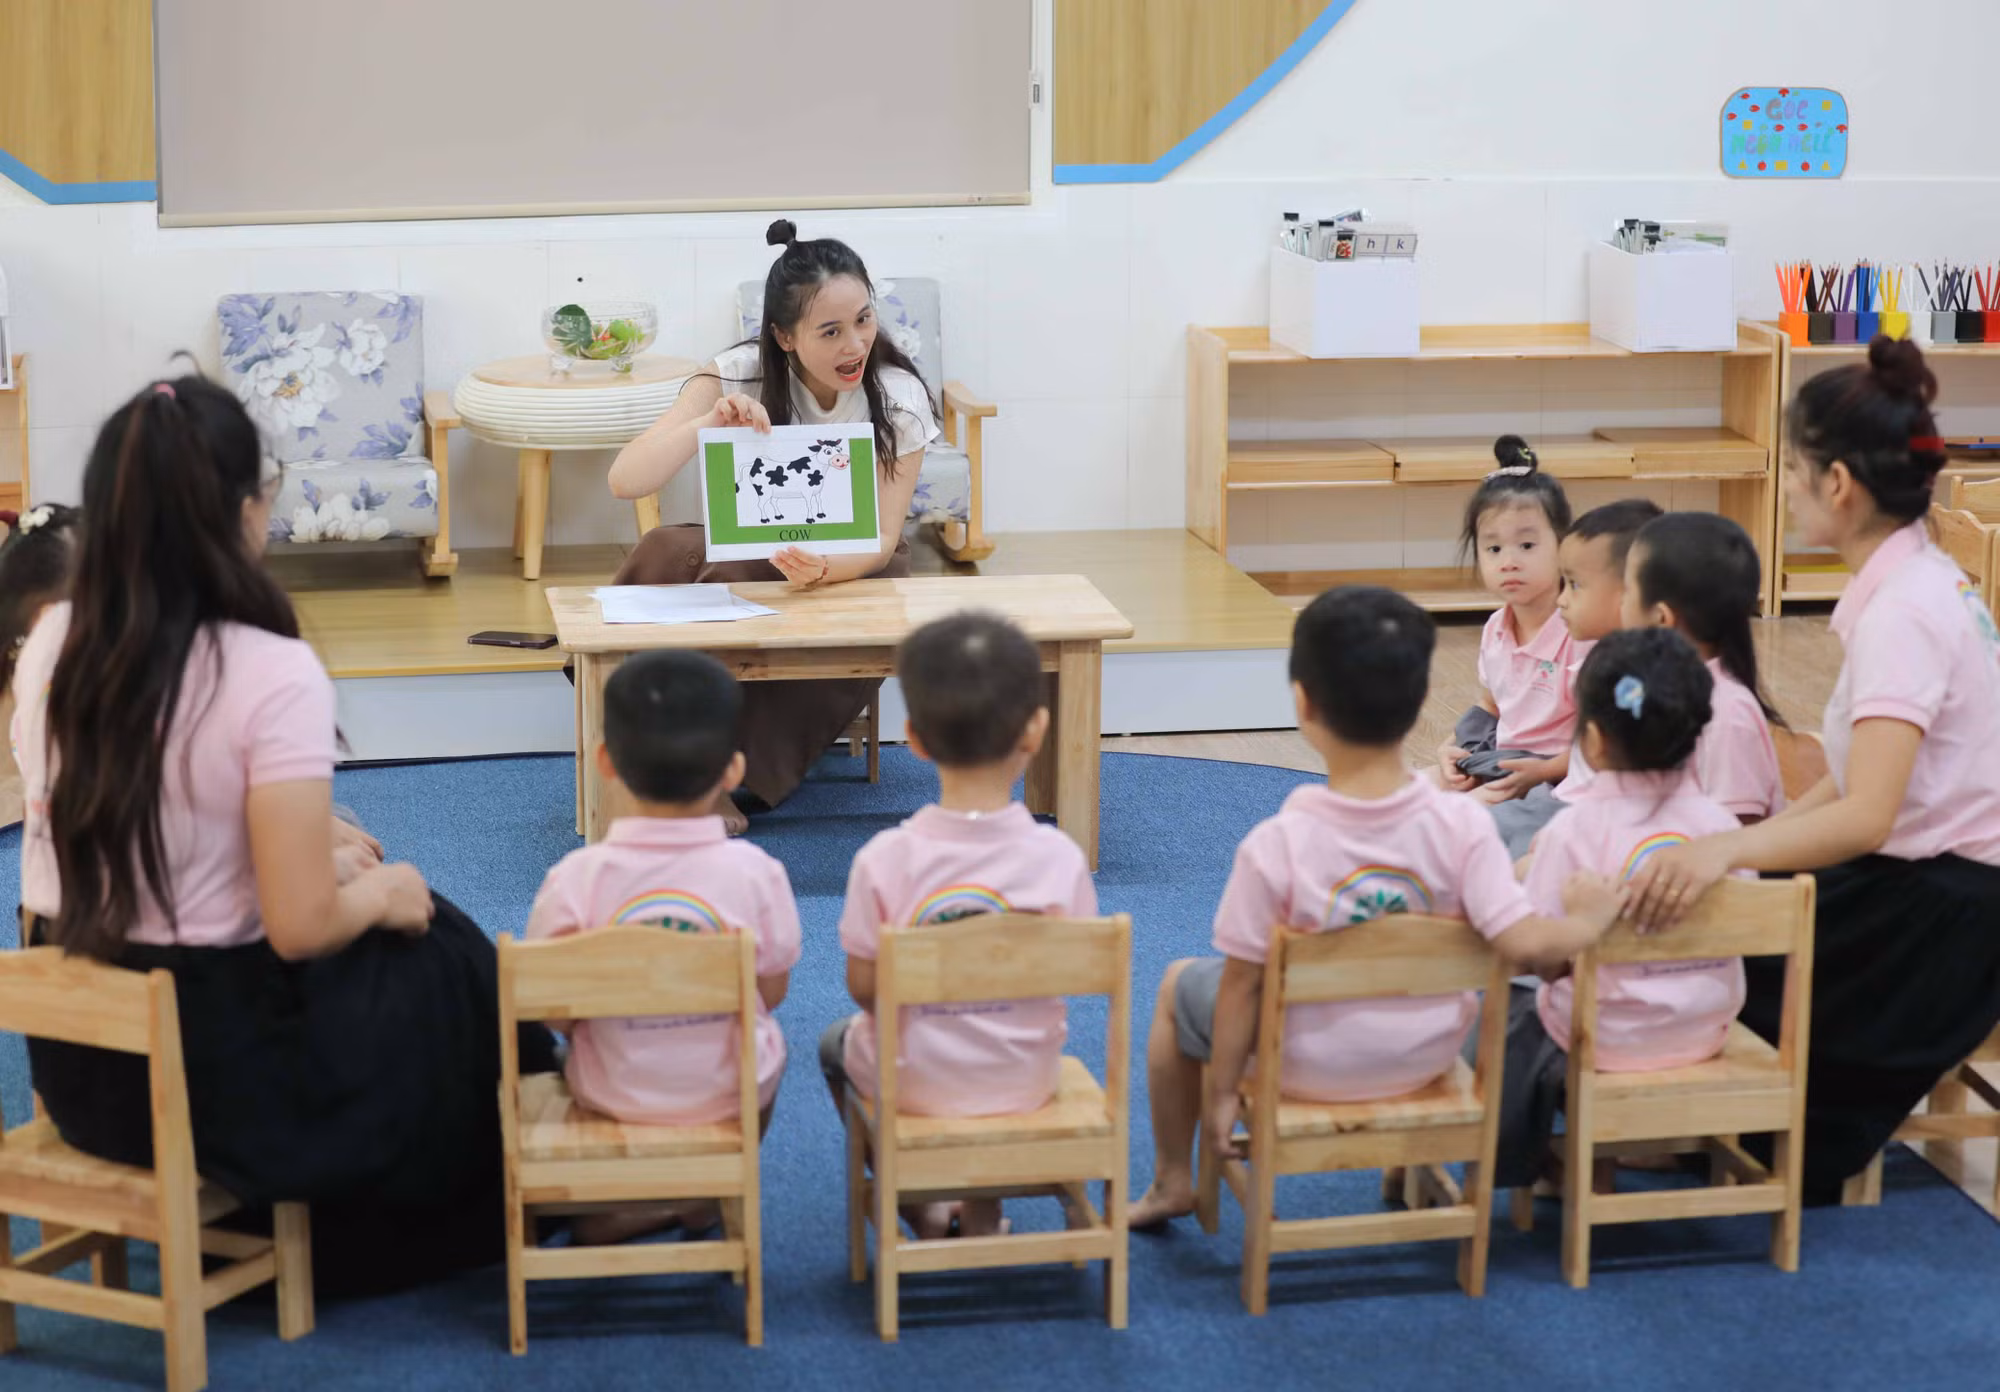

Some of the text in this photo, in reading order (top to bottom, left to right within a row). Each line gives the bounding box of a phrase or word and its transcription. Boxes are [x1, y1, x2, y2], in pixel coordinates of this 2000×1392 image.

[1366, 237, 1405, 250] h k
[779, 529, 811, 541] COW
